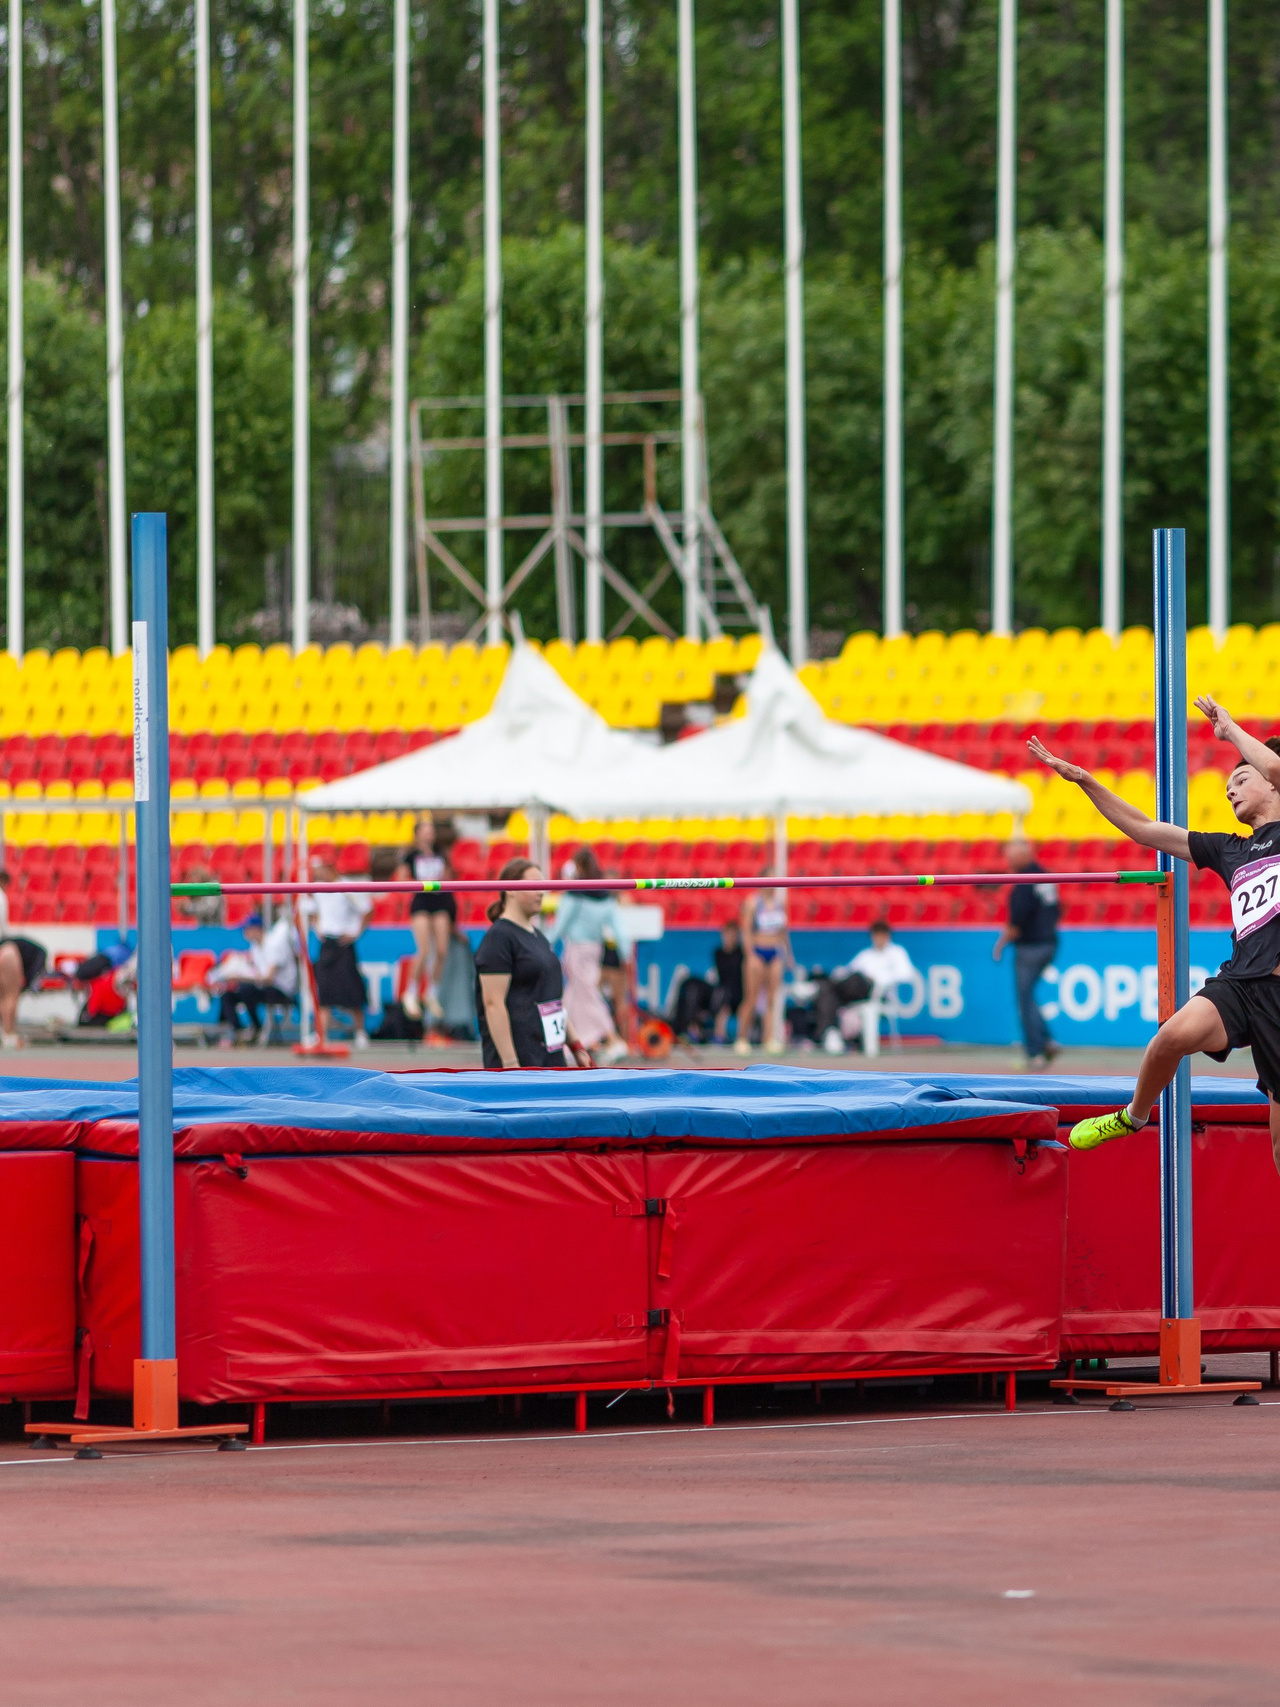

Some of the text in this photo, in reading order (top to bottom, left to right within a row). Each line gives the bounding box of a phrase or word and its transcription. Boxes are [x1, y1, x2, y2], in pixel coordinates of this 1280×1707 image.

[133, 678, 144, 762] nordicsport
[1250, 840, 1273, 851] FILA
[1238, 874, 1279, 917] 227
